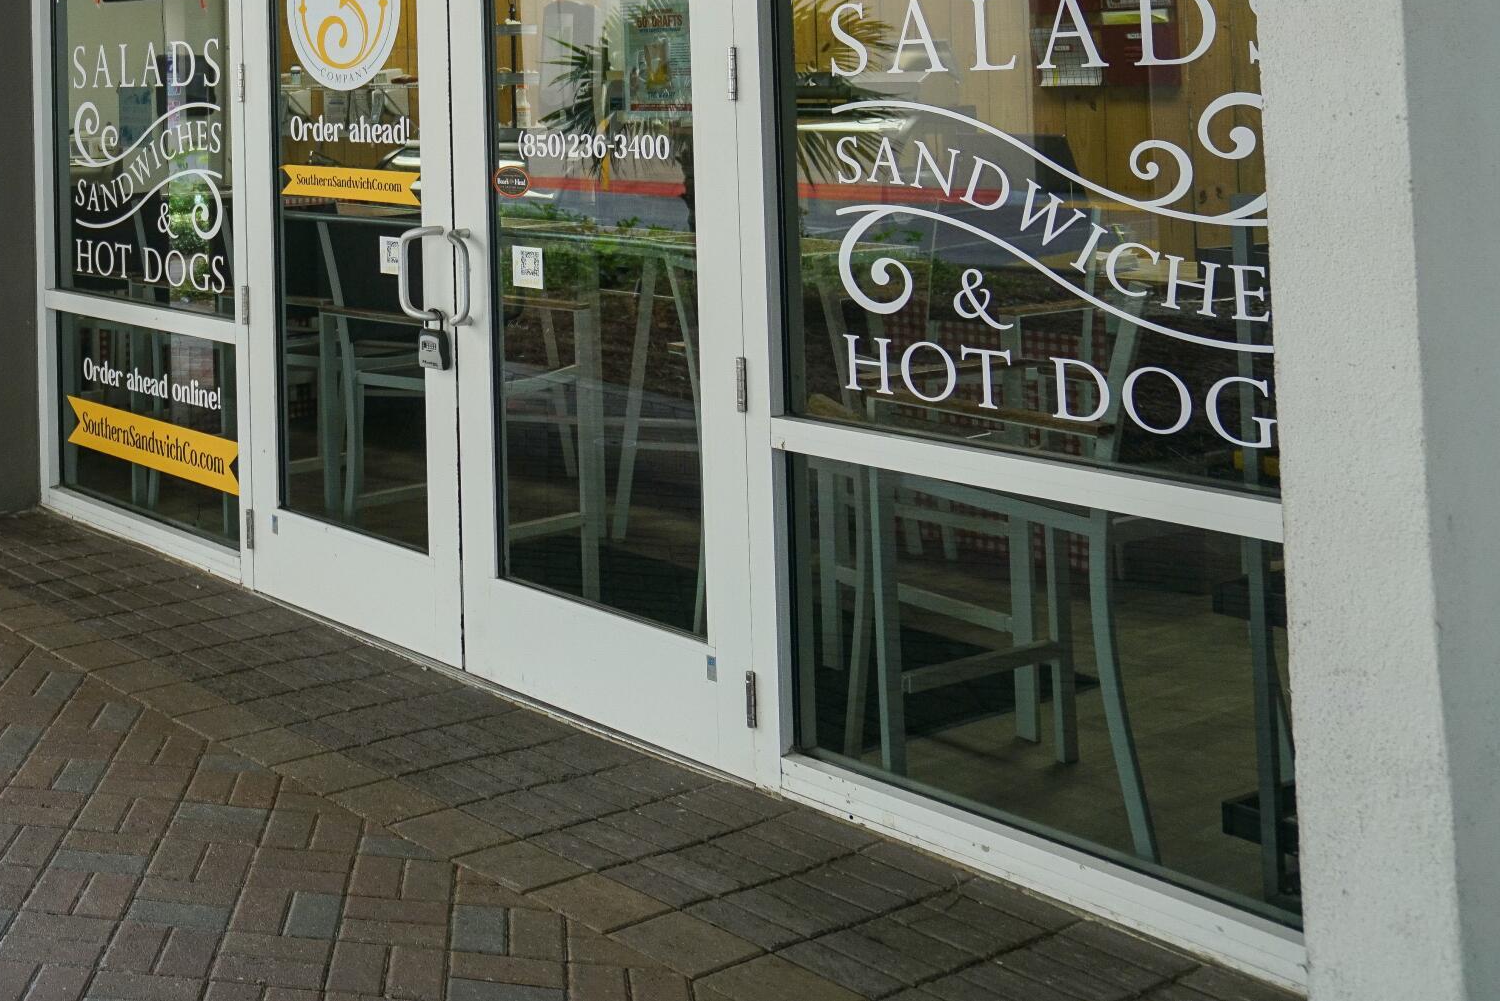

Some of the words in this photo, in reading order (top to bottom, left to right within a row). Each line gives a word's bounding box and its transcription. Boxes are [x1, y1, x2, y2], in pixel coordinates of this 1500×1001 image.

[74, 38, 221, 89] SALADS
[320, 65, 370, 84] COMPANY
[290, 115, 345, 146] Order
[349, 115, 411, 146] ahead!
[518, 130, 670, 162] (850)236-3400
[75, 120, 222, 215] SANDWICHES
[296, 172, 403, 196] SouthernSandwichCo.com
[157, 201, 179, 239] &
[837, 136, 1272, 322] SANDWICHE
[76, 238, 132, 280] HOT
[143, 247, 227, 295] DOGS
[953, 268, 1014, 330] &
[82, 356, 123, 389] Order
[126, 367, 168, 399] ahead
[172, 378, 222, 411] online!
[843, 334, 1011, 410] HOT
[1052, 357, 1278, 449] DOG
[82, 411, 226, 477] SouthernSandwichCo.com
